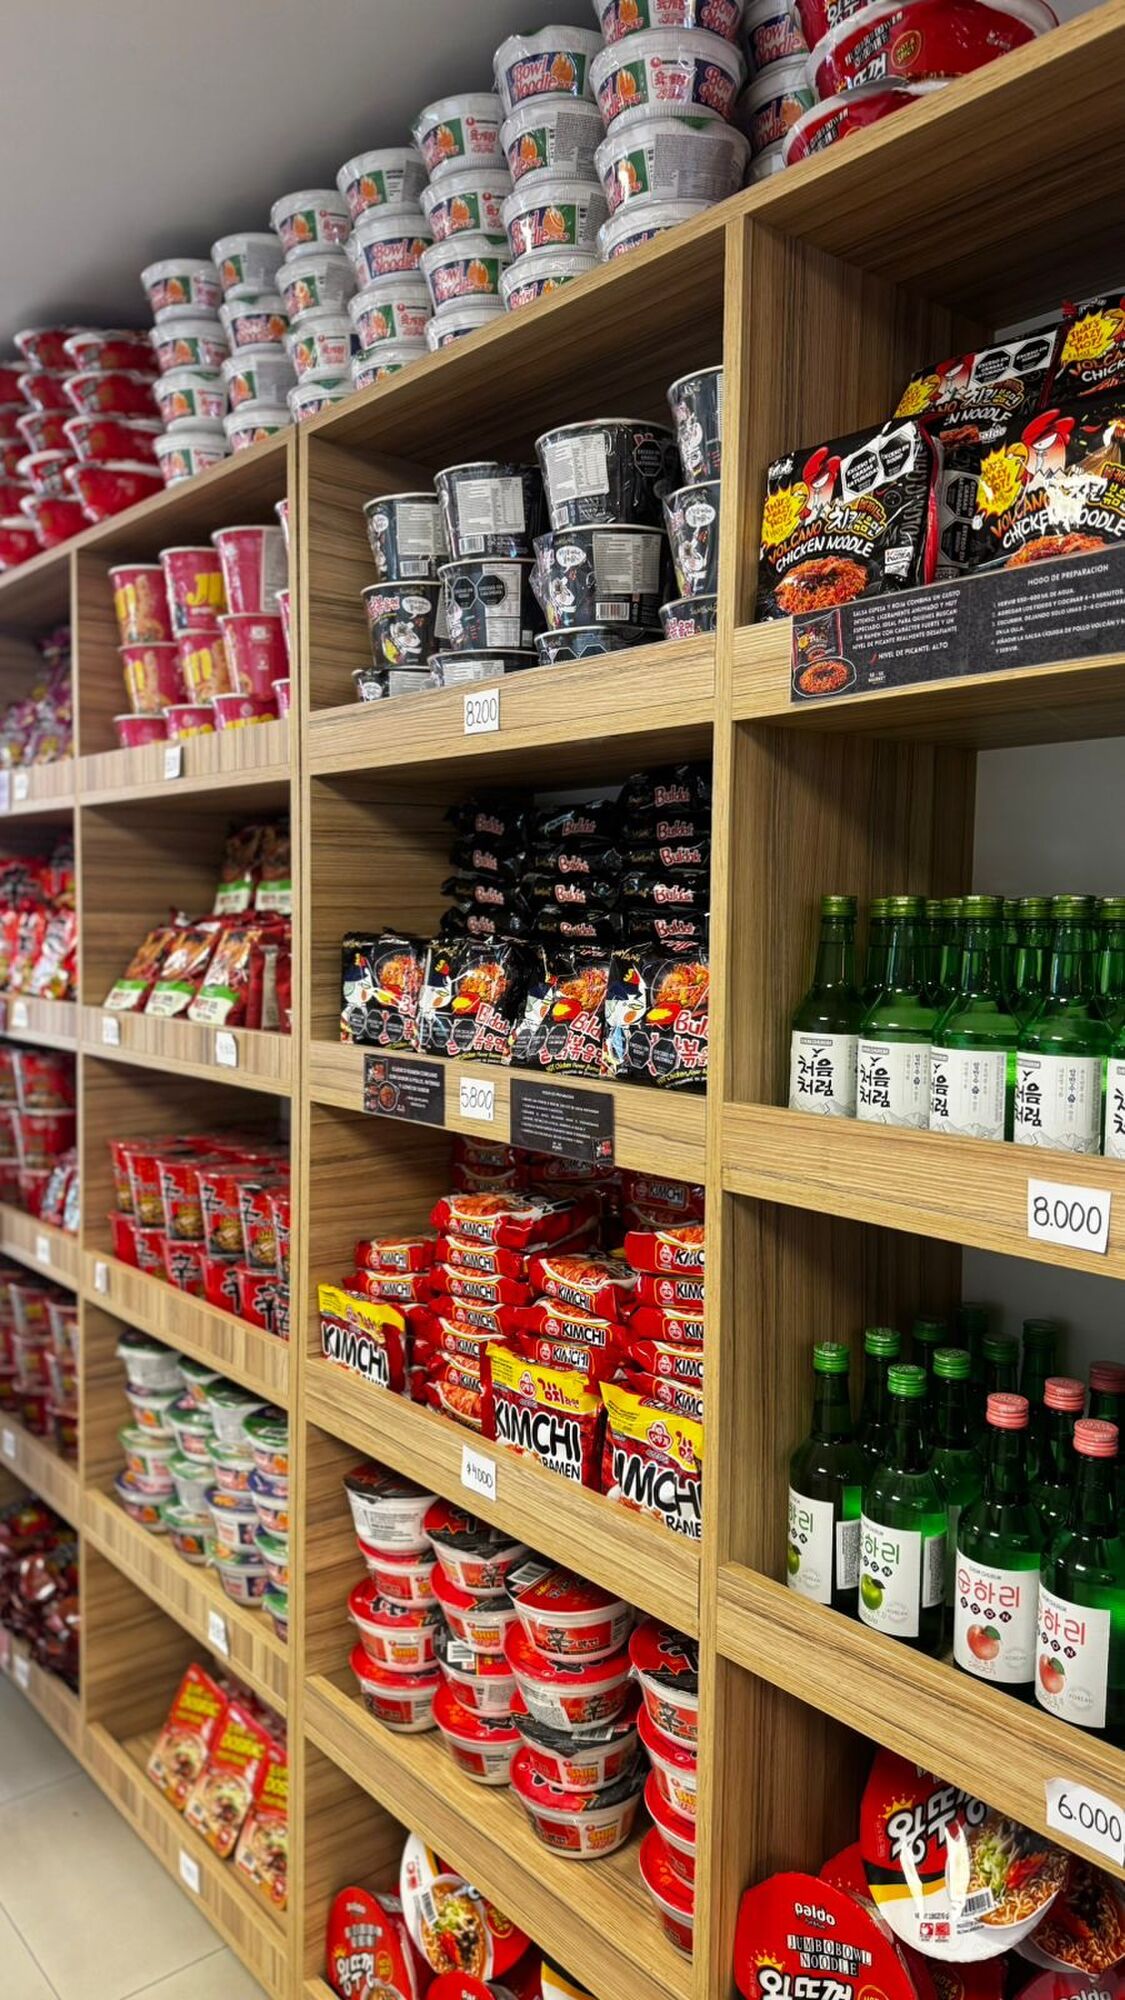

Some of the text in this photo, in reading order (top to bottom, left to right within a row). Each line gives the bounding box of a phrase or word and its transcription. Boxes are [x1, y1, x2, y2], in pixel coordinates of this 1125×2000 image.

[513, 55, 548, 80] Bowl
[515, 70, 558, 99] Noodle
[1072, 351, 1124, 374] VOLCA
[962, 407, 1012, 423] NOODLE
[990, 490, 1051, 537] VOLCAN
[1003, 511, 1060, 548] CHICKE
[1072, 508, 1125, 538] OODLE
[769, 523, 822, 562] VOLCANO
[776, 536, 875, 573] CHICKEN NOODLE
[1027, 576, 1050, 586] MODO
[1061, 564, 1109, 579] PREPARACIÓN
[932, 641, 949, 651] ALTO
[466, 698, 497, 727] 8200
[660, 846, 702, 868] Buldak
[654, 919, 697, 938] Buldak
[797, 1054, 834, 1077] 처음
[860, 1064, 890, 1088] 처음
[460, 1086, 493, 1110] 5800
[797, 1076, 834, 1097] 처럼
[860, 1086, 890, 1108] 처럼
[1033, 1196, 1102, 1235] 8.000
[675, 1250, 704, 1265] KIMC
[558, 1285, 591, 1310] KIMCHI
[675, 1281, 704, 1300] KIMC
[561, 1322, 606, 1346] KIMCHI
[321, 1321, 390, 1383] KIMCHI
[457, 1340, 480, 1357] KIMC
[552, 1345, 589, 1367] KIMCHI
[674, 1357, 704, 1378] KIMC
[674, 1390, 703, 1417] KIMC
[495, 1401, 581, 1463] KIMCHI
[541, 1458, 580, 1480] RAMEN
[665, 1515, 701, 1538] RAME
[865, 1533, 899, 1565] 하리
[958, 1568, 1020, 1608] 순하리
[1043, 1608, 1086, 1646] 하리
[1058, 1793, 1122, 1842] 6.000
[794, 1902, 836, 1926] paldo
[800, 1952, 859, 1977] NOODLE
